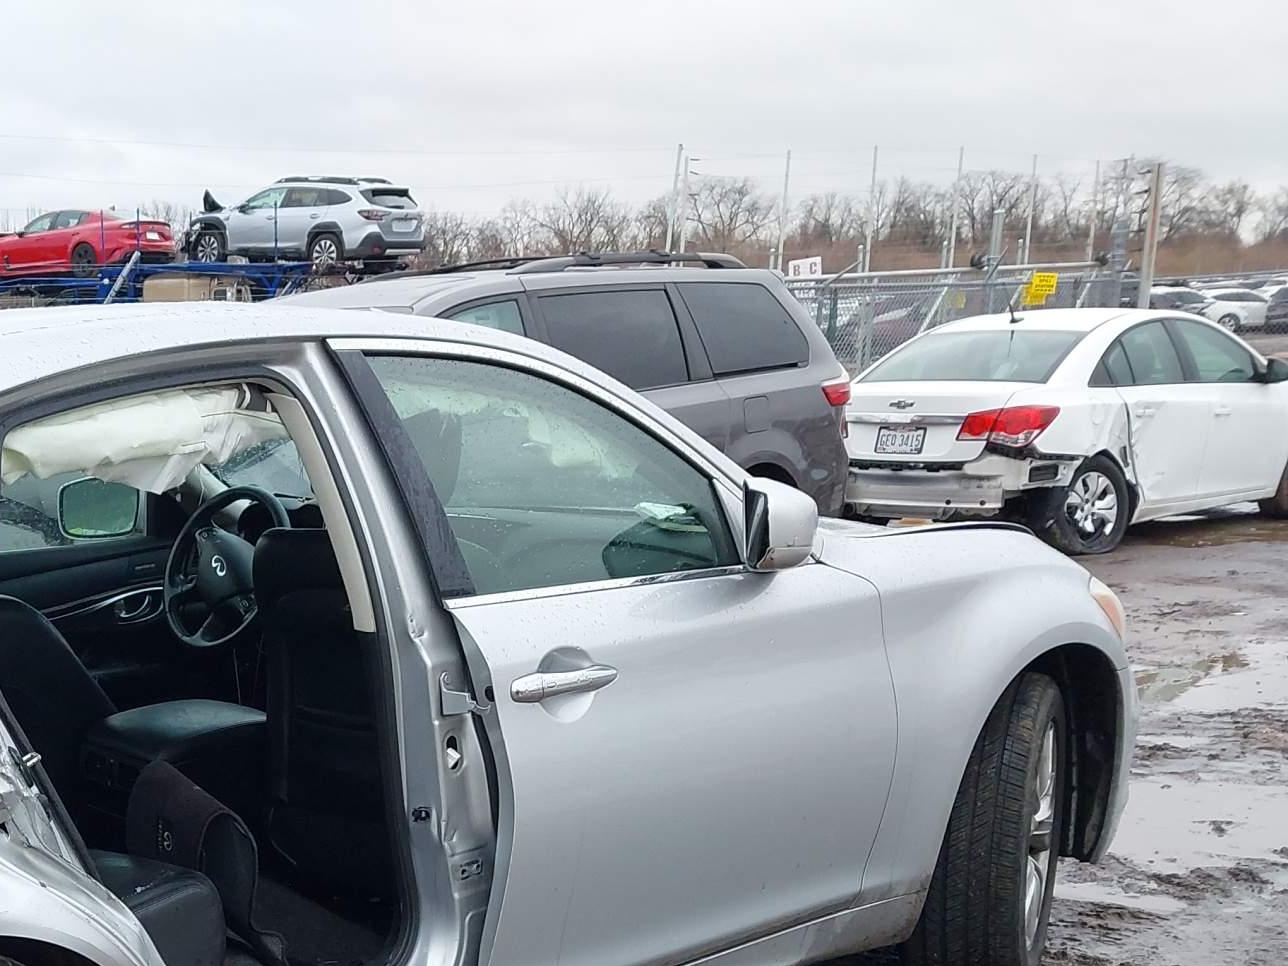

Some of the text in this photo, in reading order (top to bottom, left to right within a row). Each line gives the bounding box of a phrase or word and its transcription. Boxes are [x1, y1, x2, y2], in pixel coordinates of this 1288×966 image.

[792, 261, 818, 277] B C
[898, 433, 922, 448] 3415
